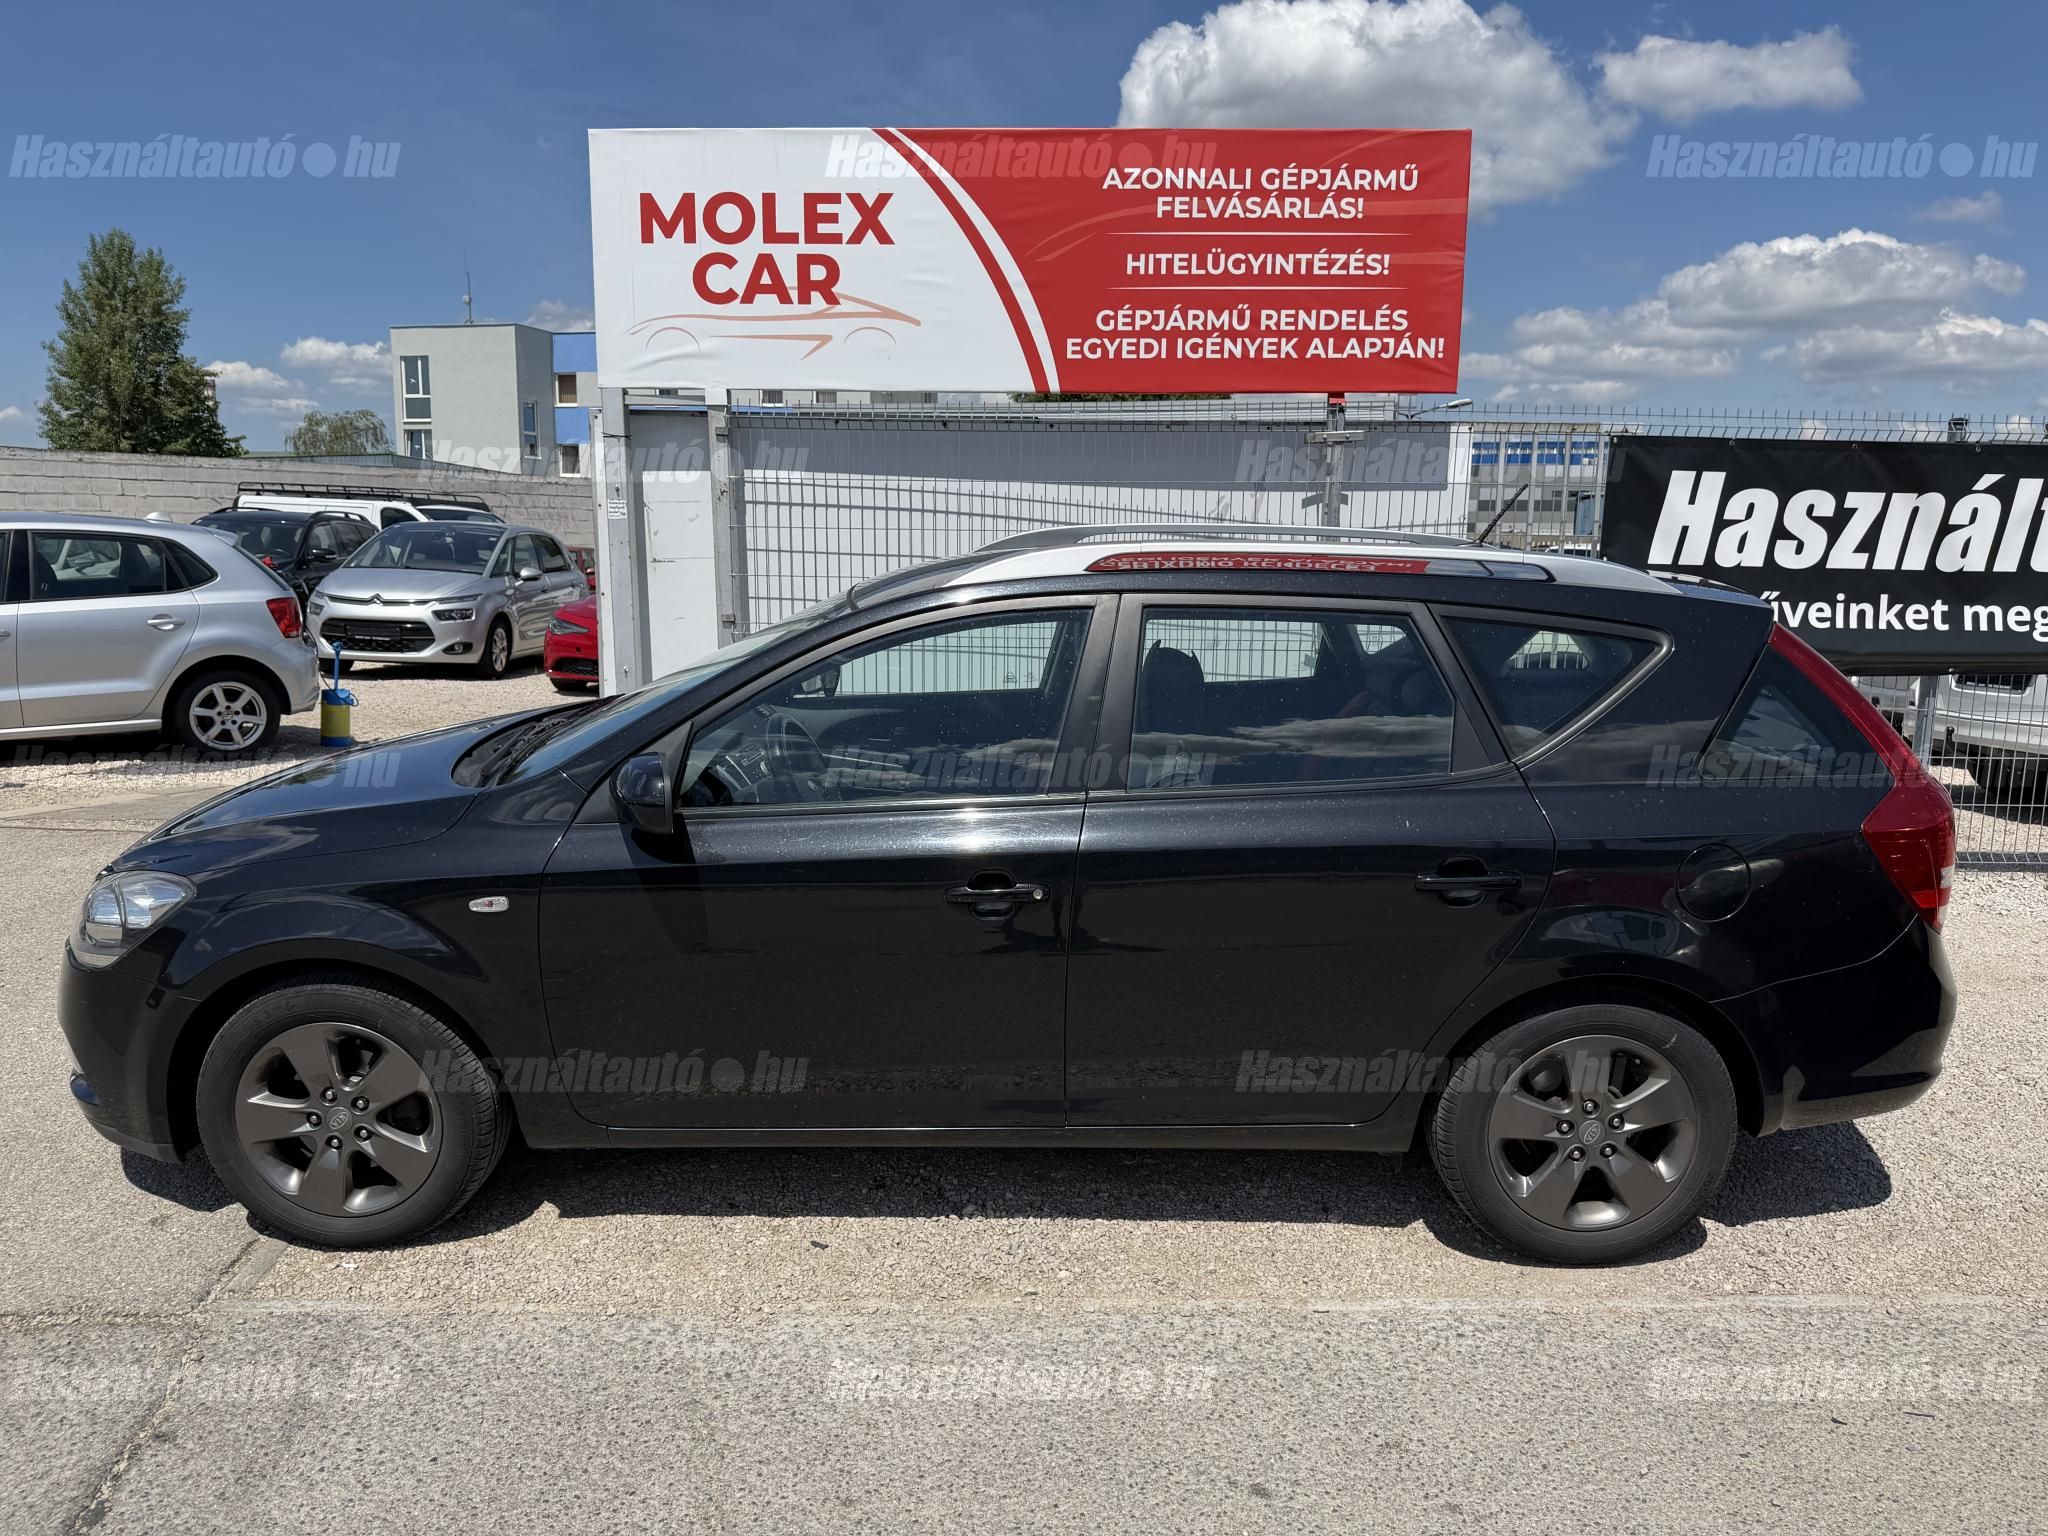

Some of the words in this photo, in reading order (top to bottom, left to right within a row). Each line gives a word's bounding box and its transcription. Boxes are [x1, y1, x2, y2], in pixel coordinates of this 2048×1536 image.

[1102, 166, 1252, 191] AZONNALI
[1260, 162, 1419, 192] GÉPJÁRMŰ
[639, 191, 895, 246] MOLEX
[1155, 193, 1365, 220] FELVÁSÁRLÁS!
[1125, 247, 1390, 276] HITELÜGYINTÉZÉS!
[692, 251, 841, 306] CAR
[1095, 303, 1251, 332] GÉPJÁRMŰ
[1259, 303, 1409, 331] RENDELÉS
[1066, 336, 1168, 360] EGYEDI
[1176, 332, 1299, 360] IGÉNYEK
[1305, 334, 1445, 360] ALAPJÁN!
